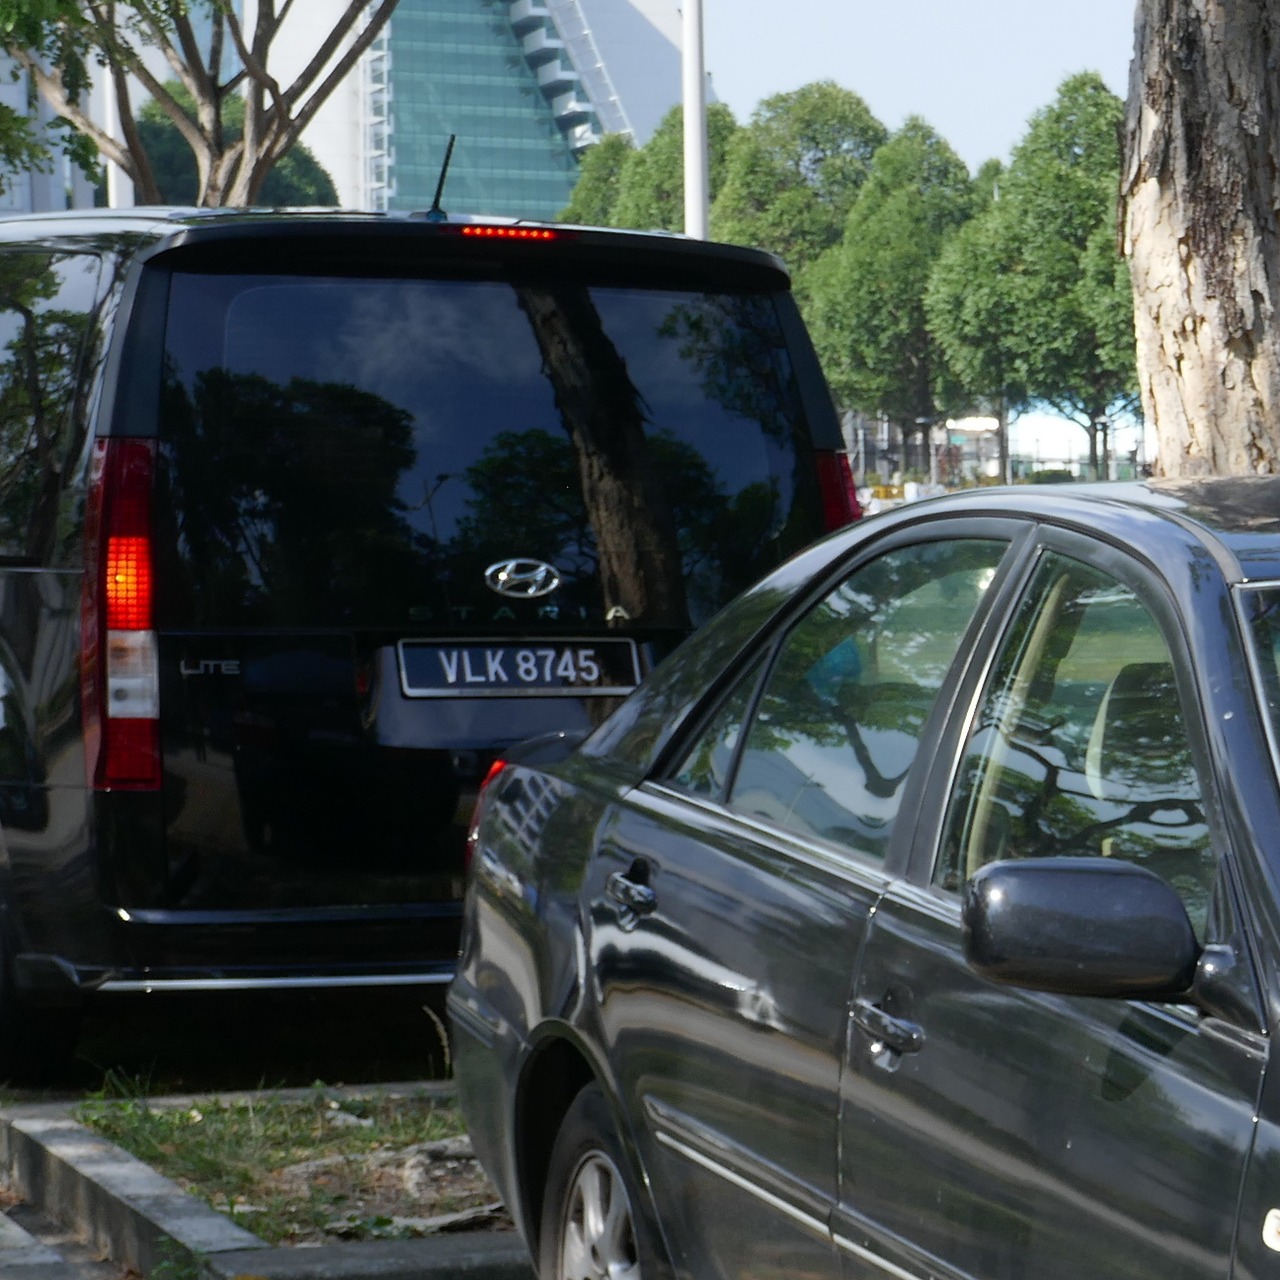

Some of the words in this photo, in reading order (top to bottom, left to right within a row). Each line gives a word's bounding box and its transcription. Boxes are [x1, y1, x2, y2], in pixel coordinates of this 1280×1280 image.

[408, 606, 630, 621] STARIA
[180, 660, 241, 679] LITE
[438, 650, 508, 683] VLK
[516, 649, 599, 683] 8745
